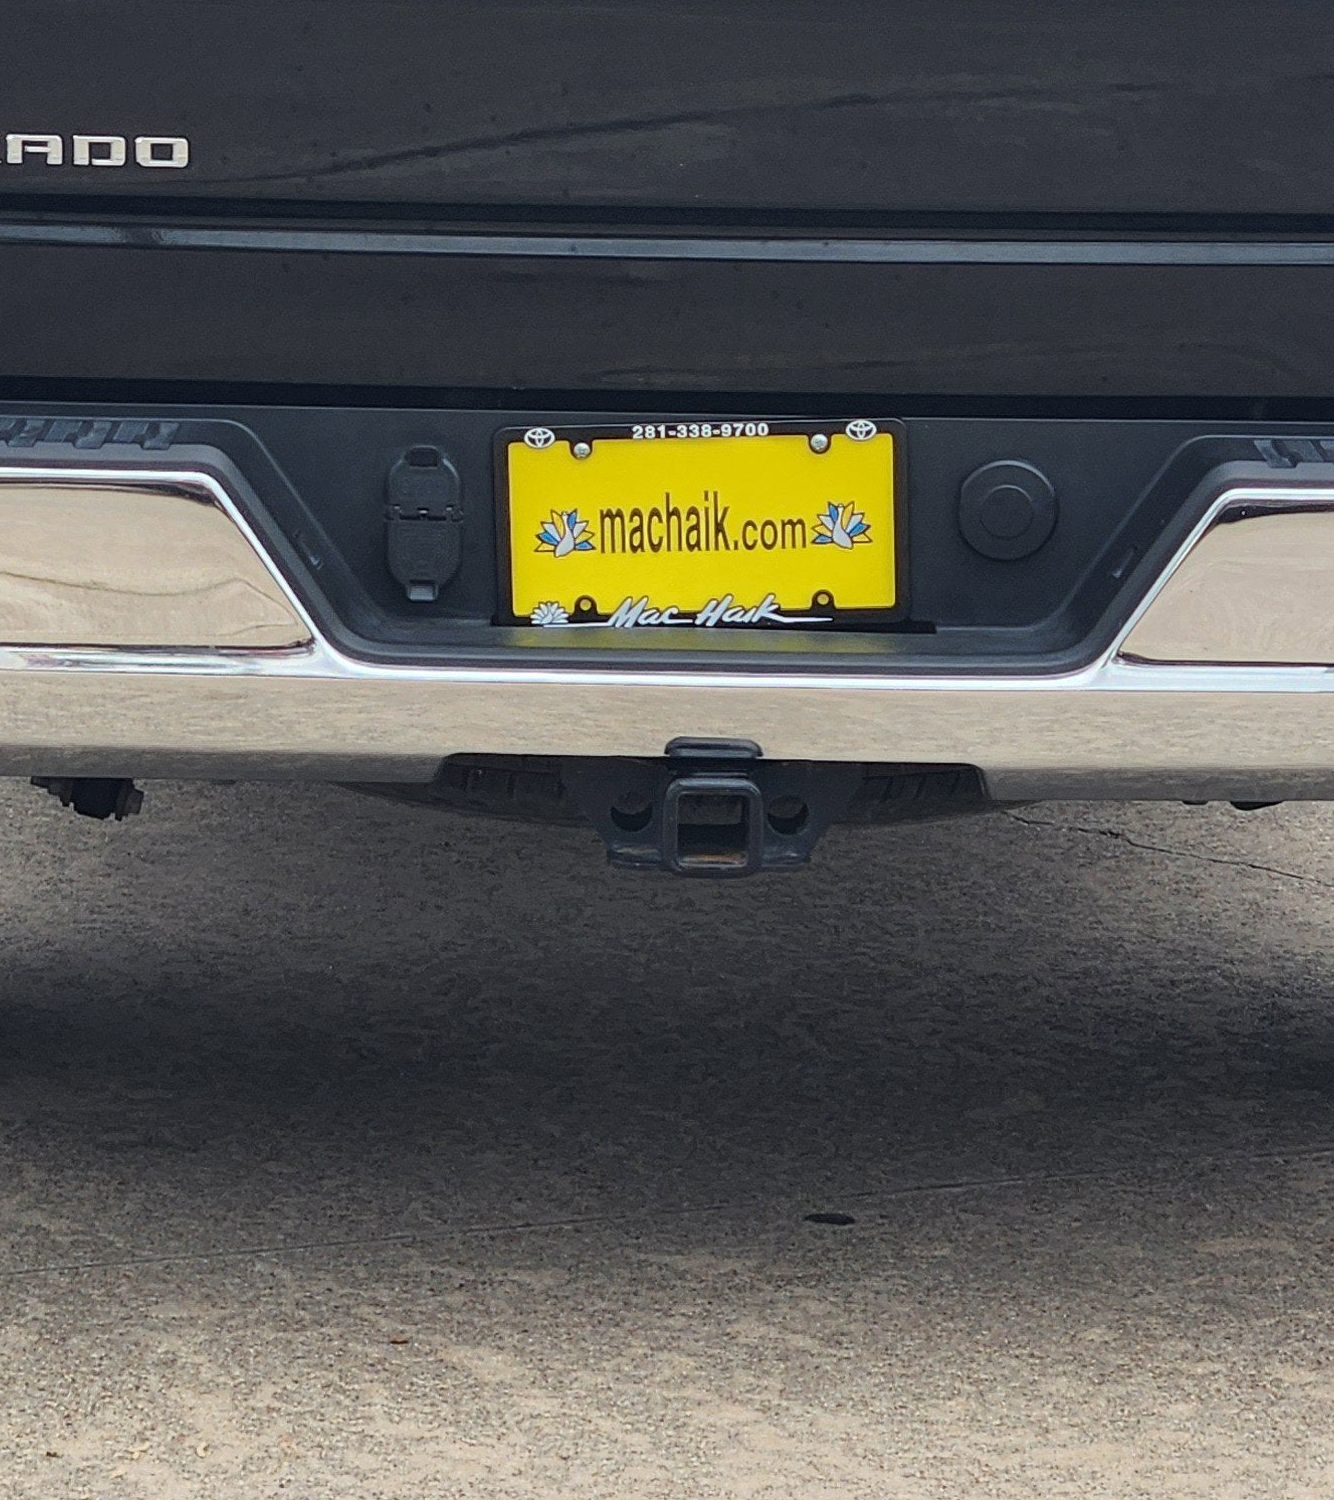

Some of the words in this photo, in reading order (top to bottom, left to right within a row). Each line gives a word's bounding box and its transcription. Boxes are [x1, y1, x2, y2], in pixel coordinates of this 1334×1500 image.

[631, 422, 770, 441] 281-338-9700
[599, 490, 808, 554] machaik.com
[605, 596, 693, 628] Mac
[693, 592, 833, 627] Haik
